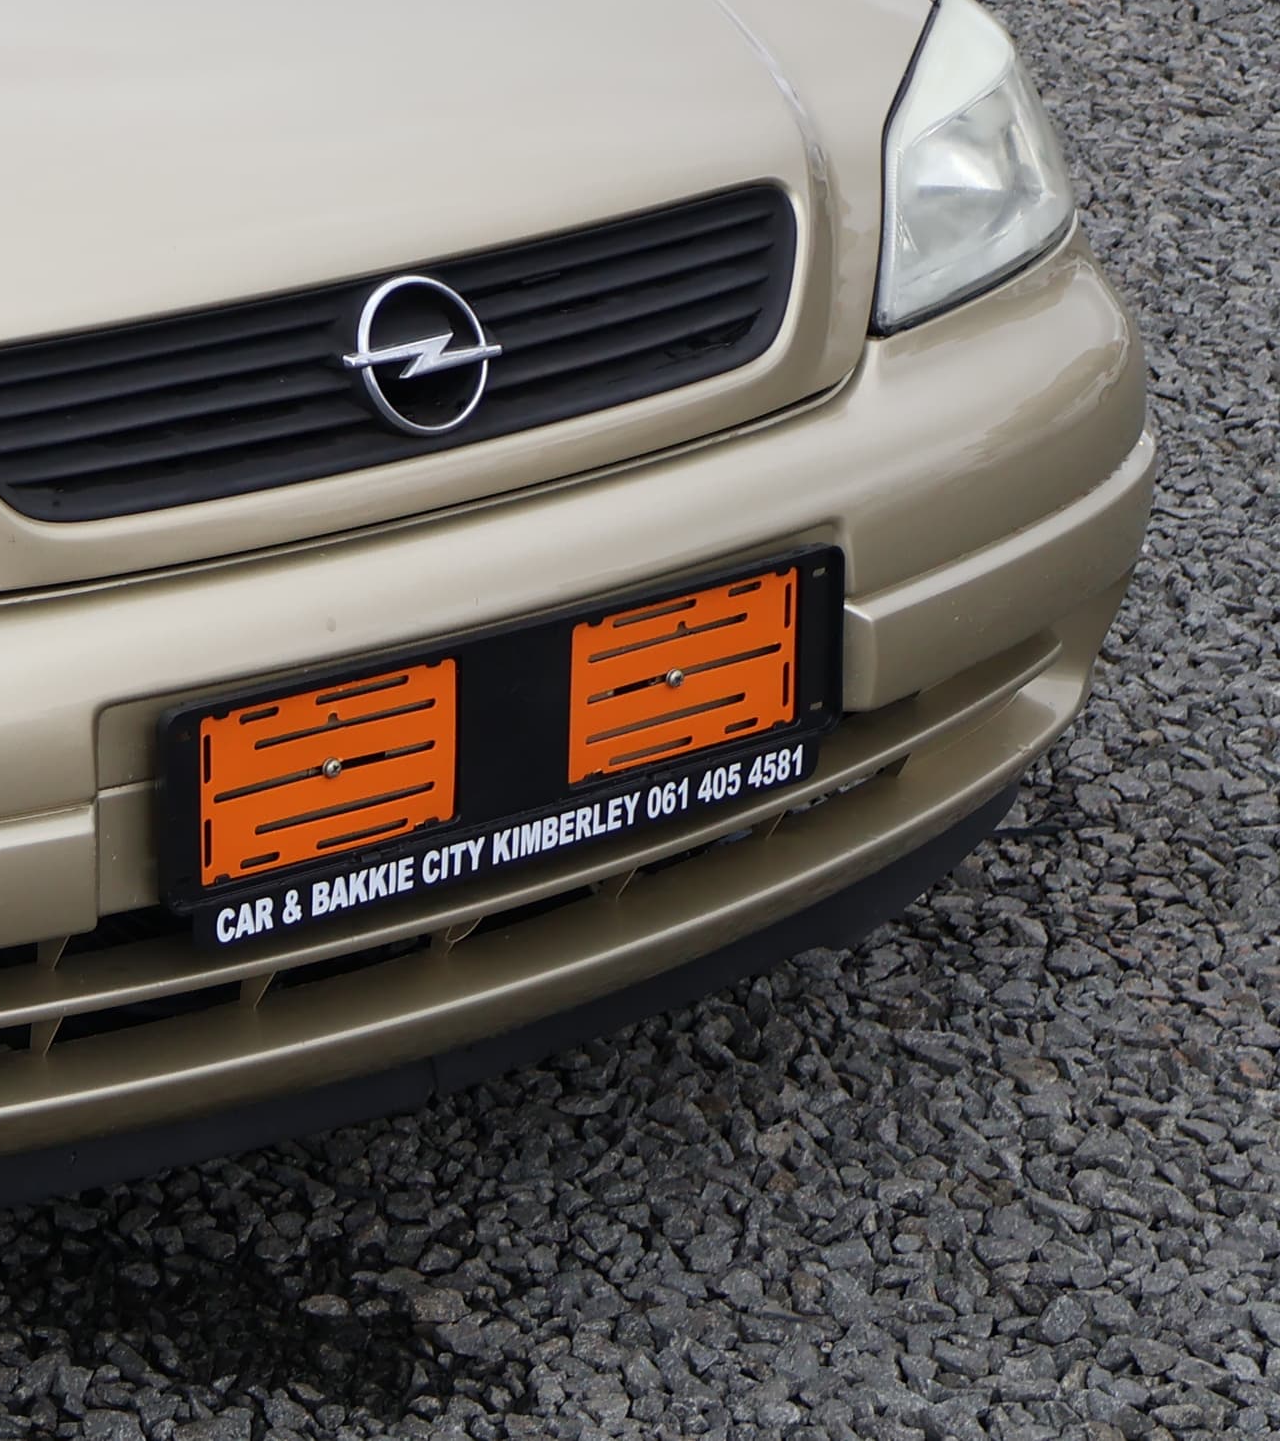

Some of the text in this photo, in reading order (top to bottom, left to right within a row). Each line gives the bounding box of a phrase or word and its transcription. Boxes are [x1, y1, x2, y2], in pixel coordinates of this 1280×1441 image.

[216, 743, 804, 944] CAR & BAKKIE CITY KIMBERLEY 061 405 4581
